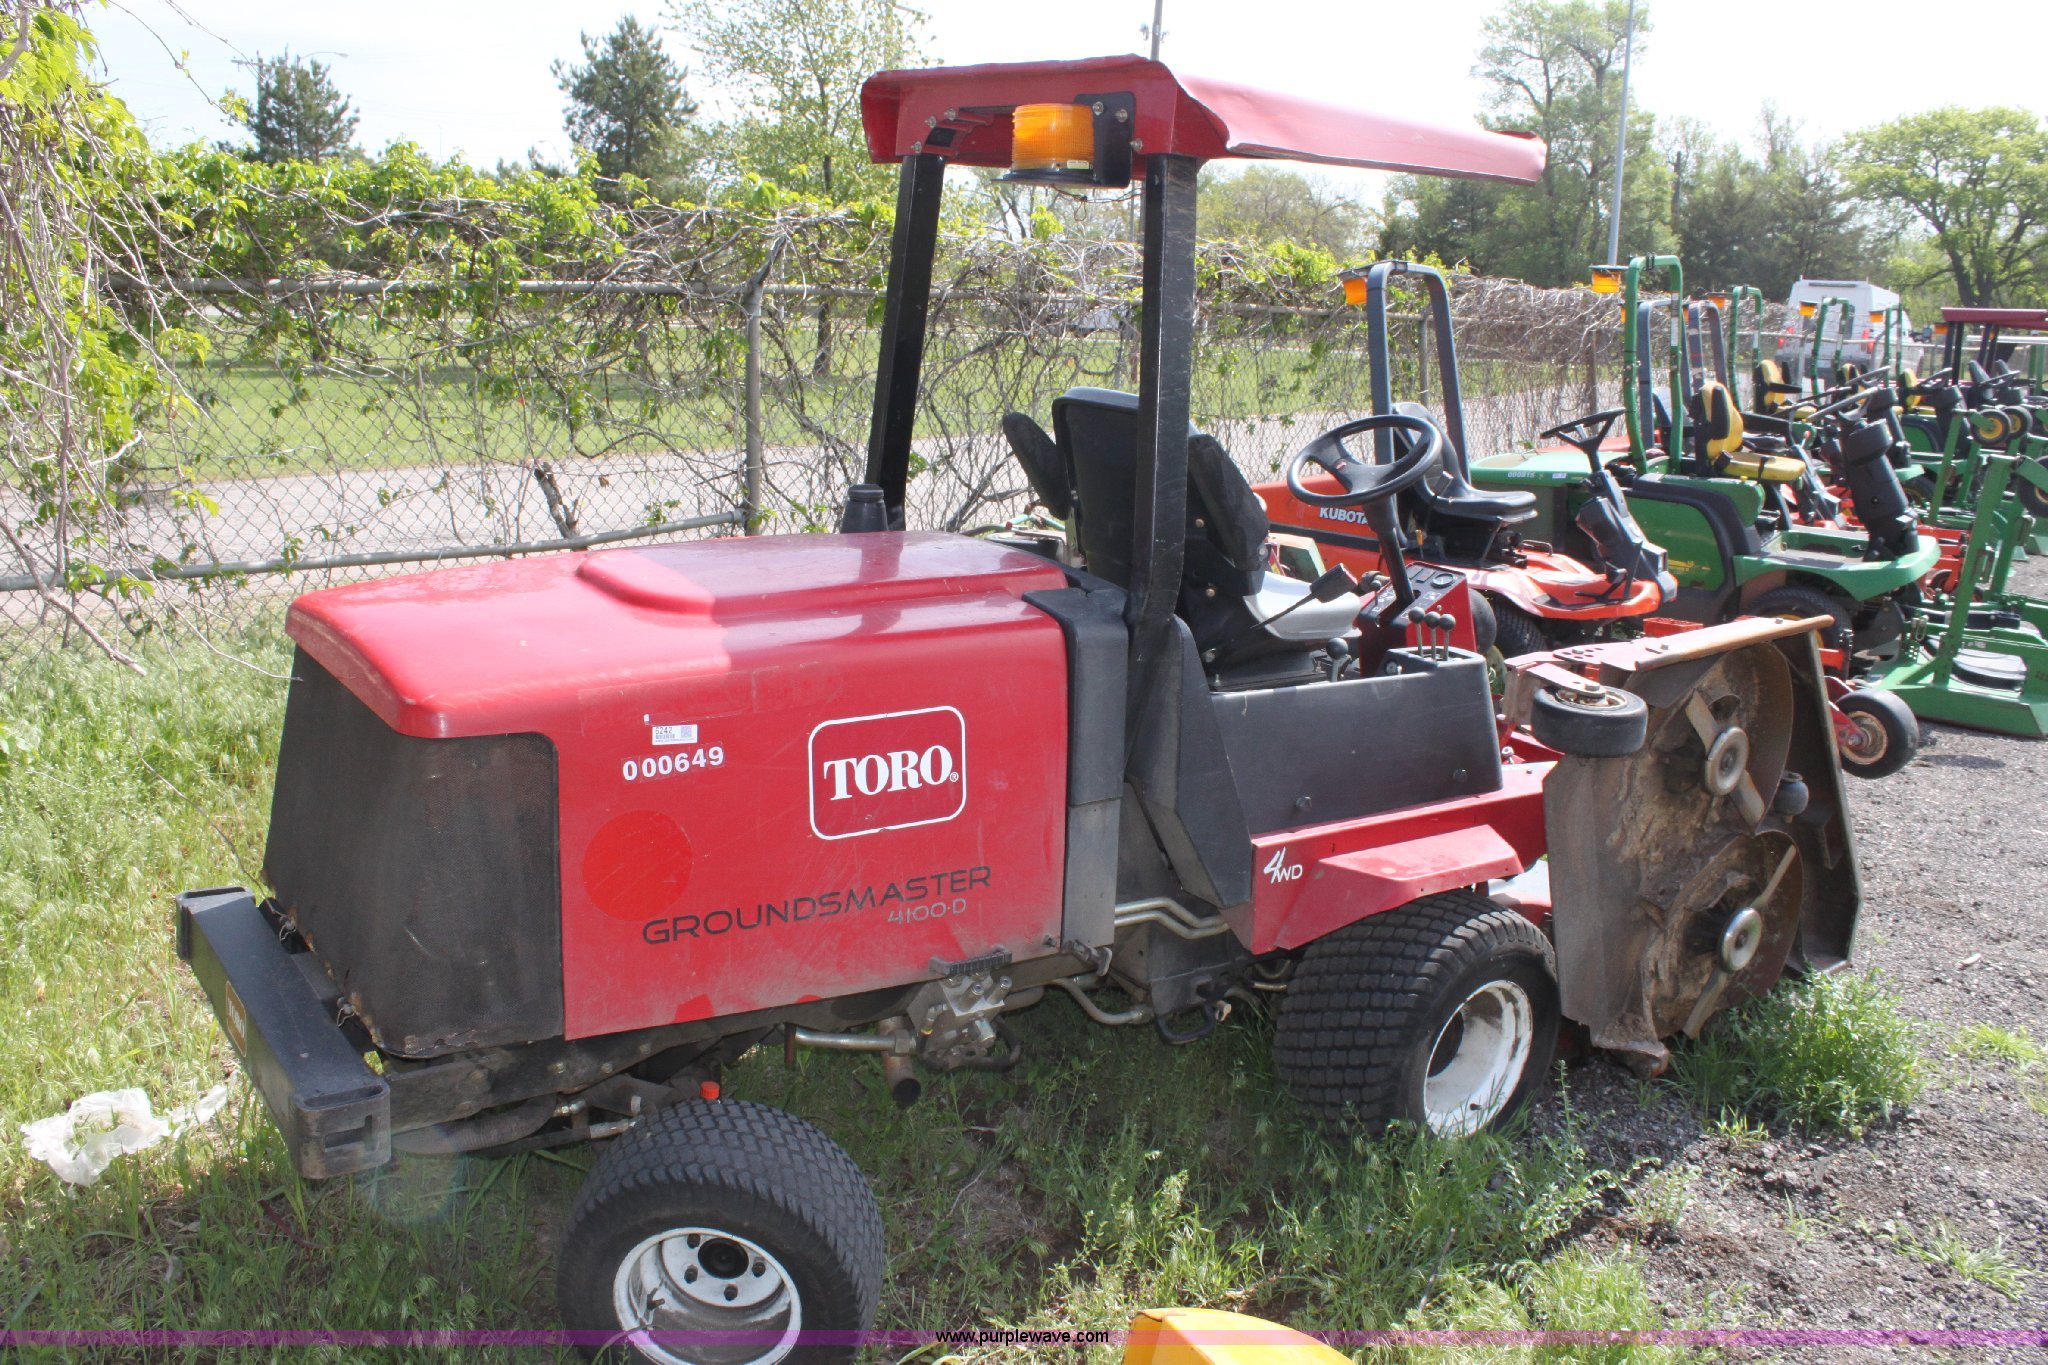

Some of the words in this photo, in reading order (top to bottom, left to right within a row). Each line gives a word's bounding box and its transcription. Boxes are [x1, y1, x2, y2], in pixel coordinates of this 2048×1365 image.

[1319, 507, 1369, 525] KUBOTA
[622, 746, 724, 781] 000649
[823, 745, 953, 800] TORO
[1263, 846, 1303, 884] 4WD
[642, 865, 991, 945] GROUNDSMASTER
